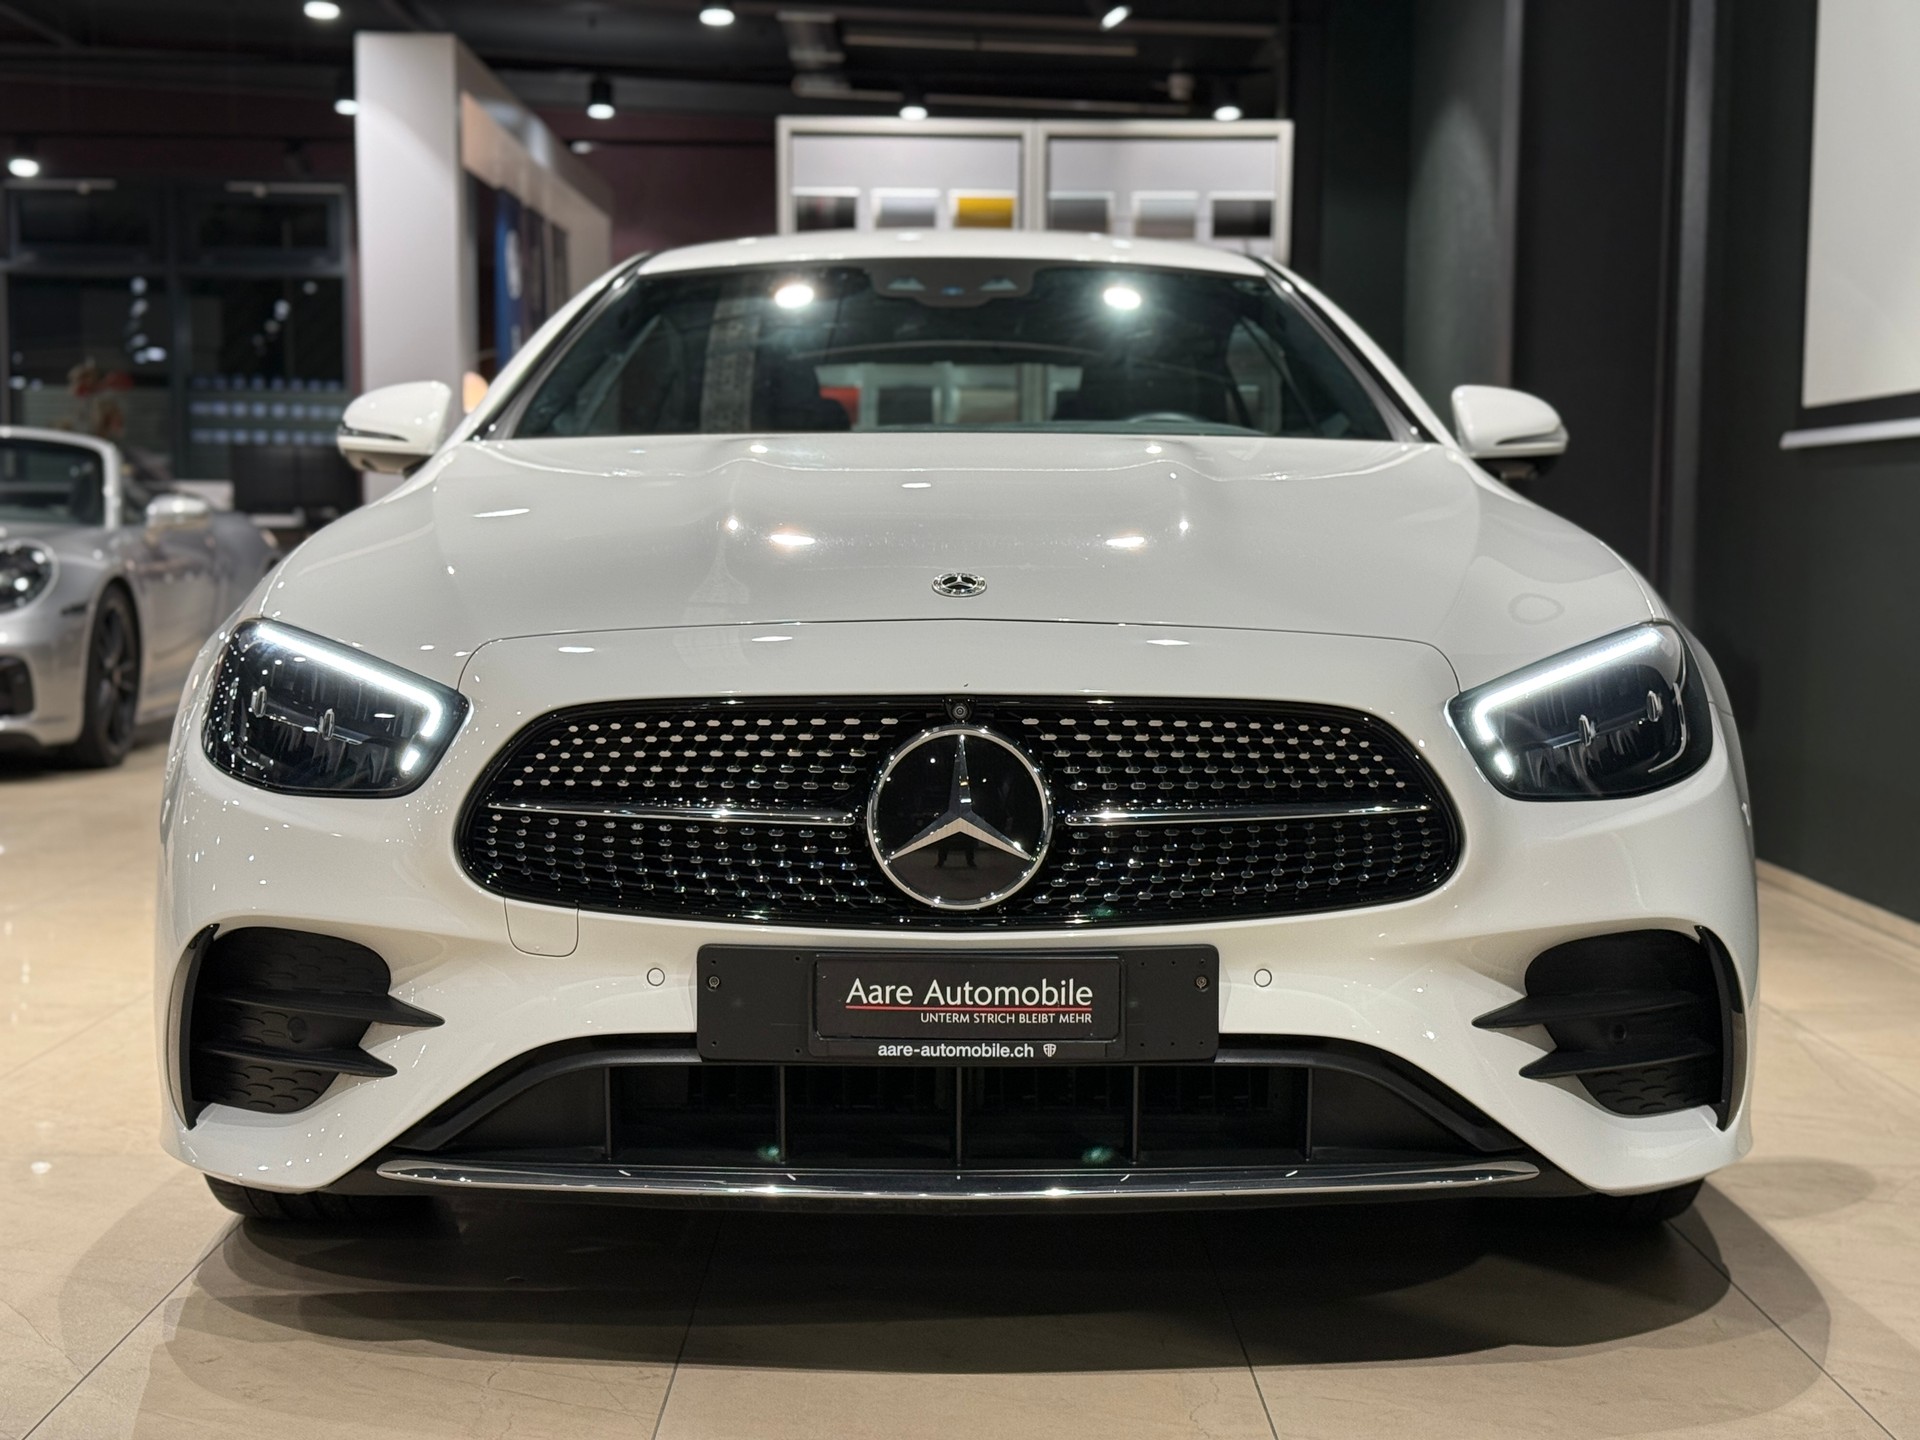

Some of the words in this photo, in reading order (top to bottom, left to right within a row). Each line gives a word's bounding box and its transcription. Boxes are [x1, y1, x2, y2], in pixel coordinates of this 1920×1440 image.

[845, 977, 913, 1006] Aare
[922, 977, 1093, 1007] Automobile
[920, 1012, 970, 1024] UNTERM
[973, 1012, 1016, 1024] STRICH
[1018, 1012, 1056, 1024] BLEIBT
[1058, 1012, 1093, 1024] MEHR
[877, 1042, 1035, 1058] aare-automobile.ch
